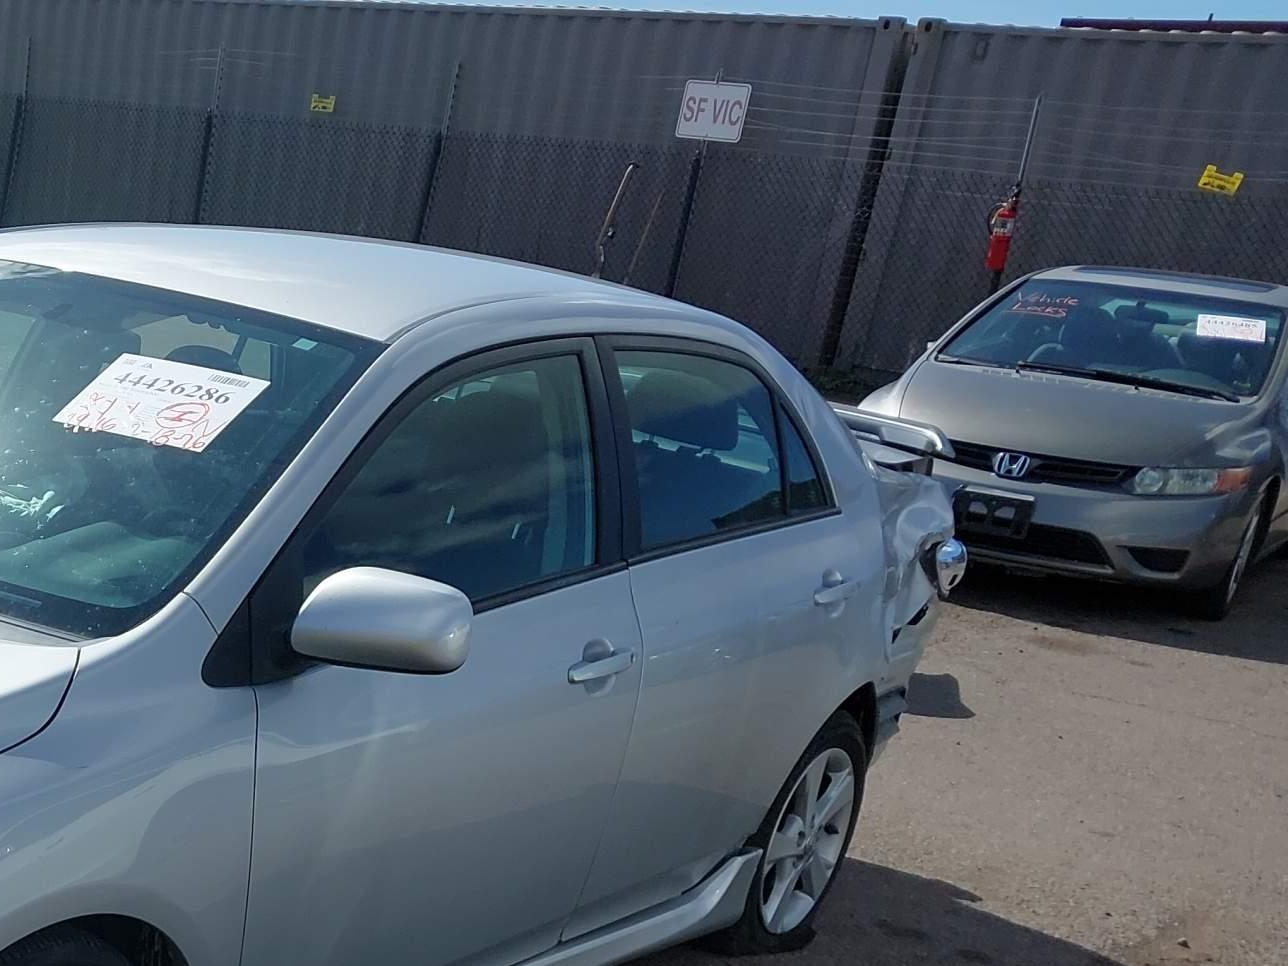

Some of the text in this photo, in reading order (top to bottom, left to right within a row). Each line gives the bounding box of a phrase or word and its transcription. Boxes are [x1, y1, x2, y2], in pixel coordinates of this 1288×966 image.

[683, 95, 743, 126] SF VIC
[114, 372, 237, 404] 44426286
